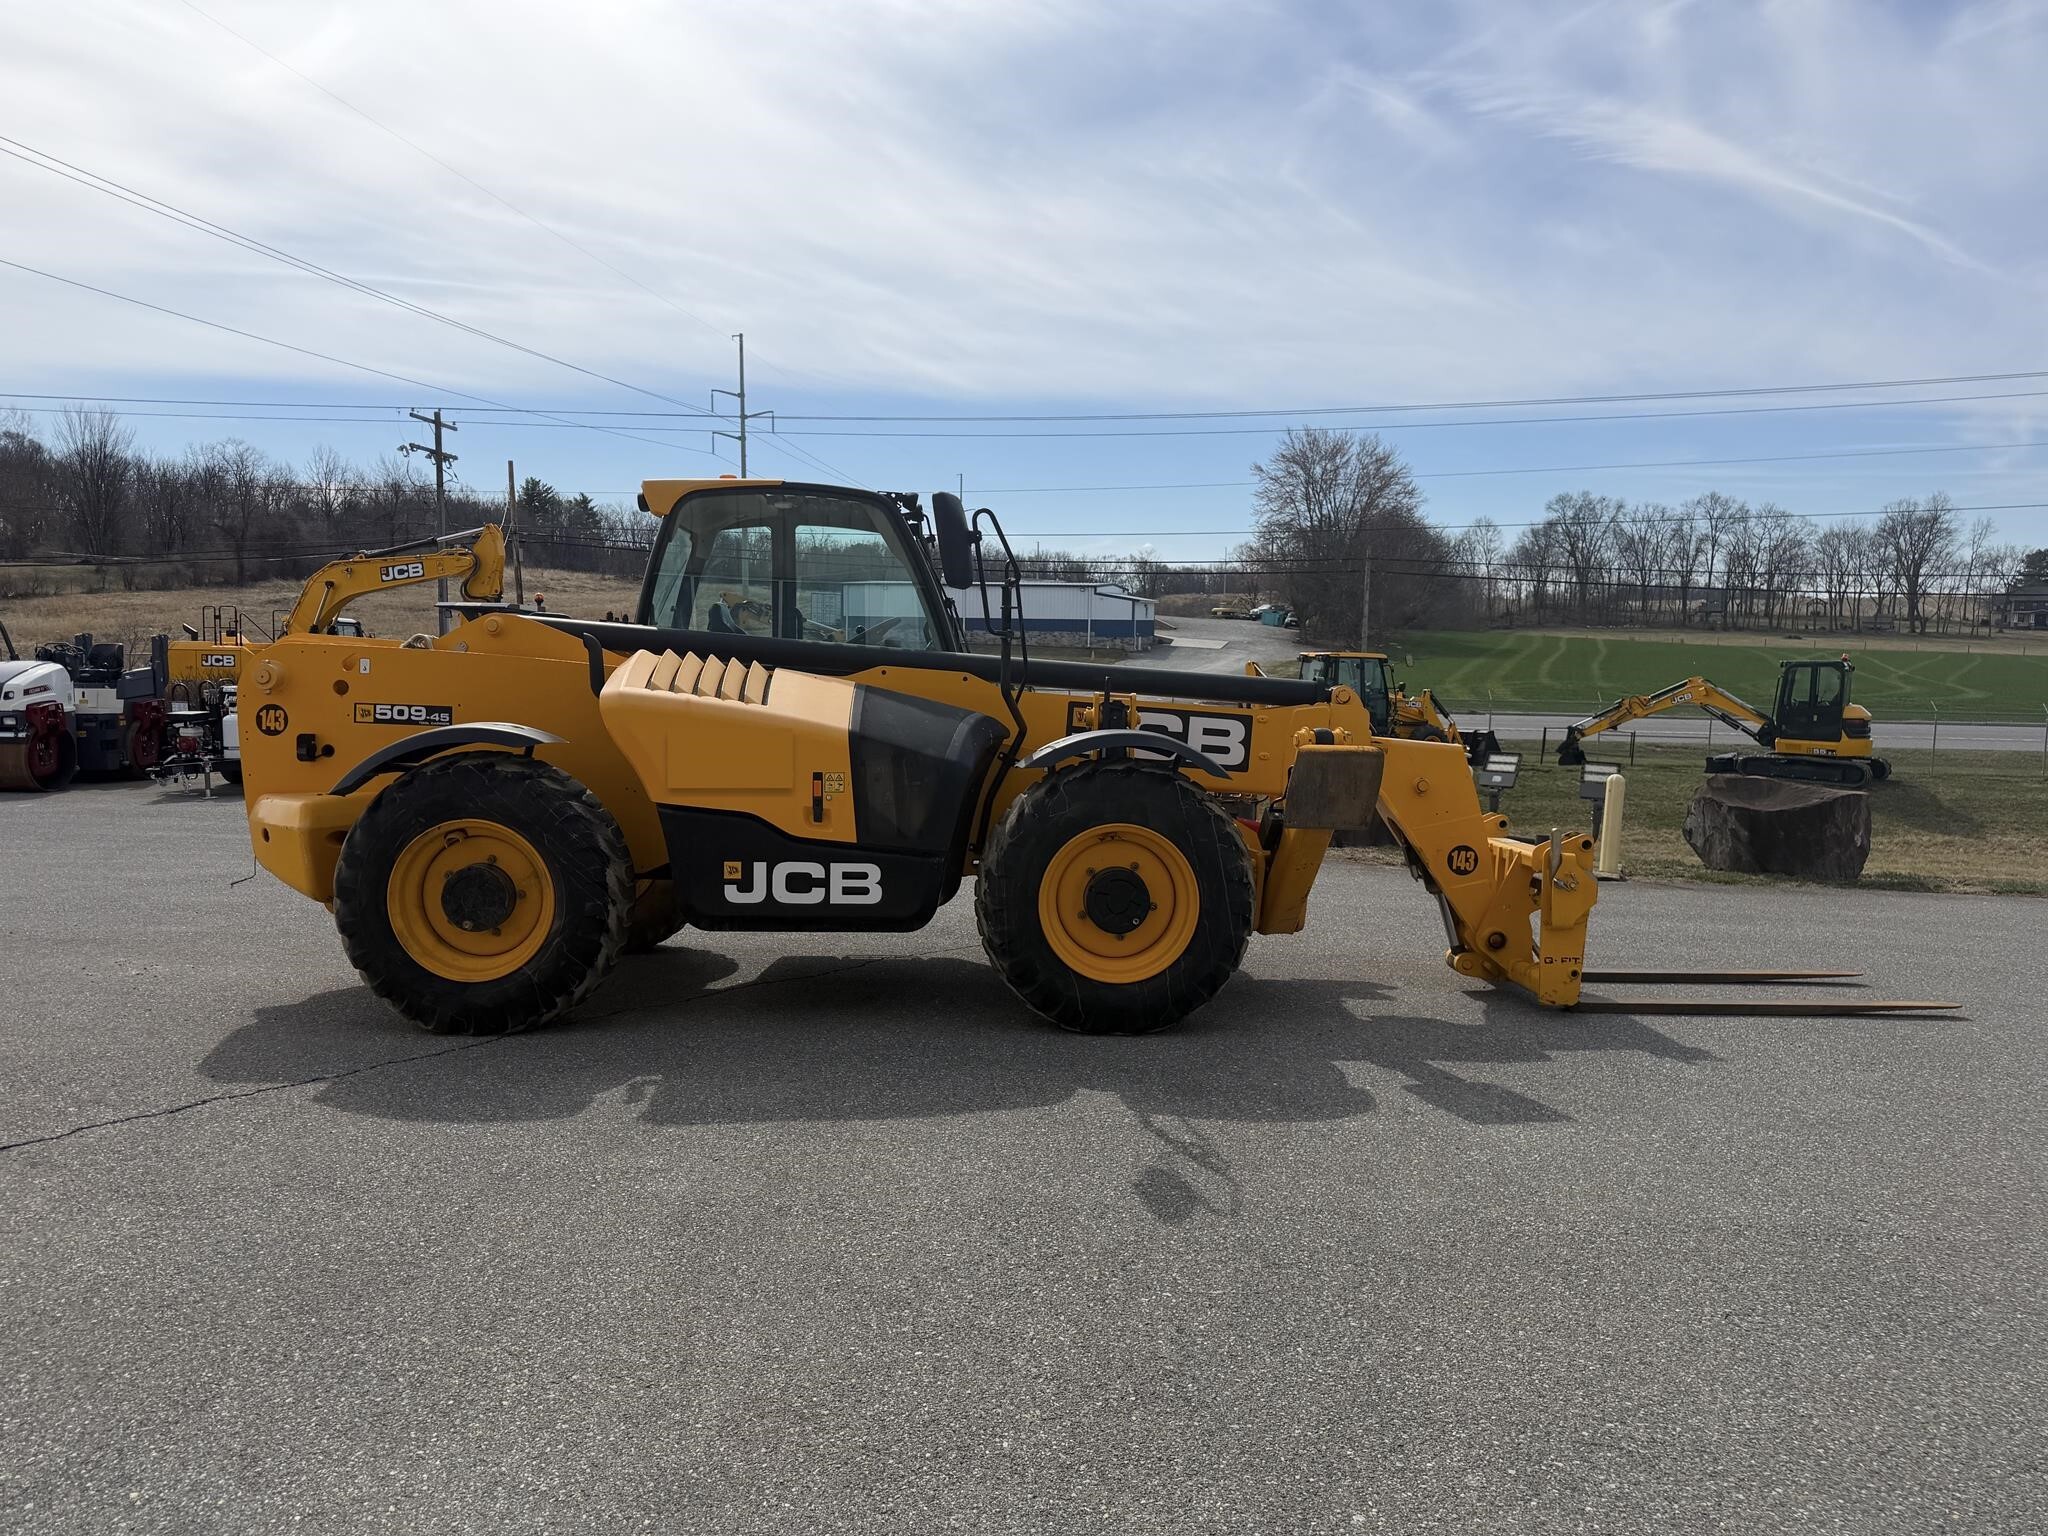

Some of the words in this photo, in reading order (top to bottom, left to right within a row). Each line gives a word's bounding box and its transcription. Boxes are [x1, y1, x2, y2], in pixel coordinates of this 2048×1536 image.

[381, 563, 424, 580] JCB
[202, 655, 235, 666] JCB
[260, 709, 285, 731] 143
[375, 704, 450, 721] 509-45
[1071, 707, 1247, 766] CB
[1451, 850, 1476, 871] 143
[724, 861, 883, 904] JCB
